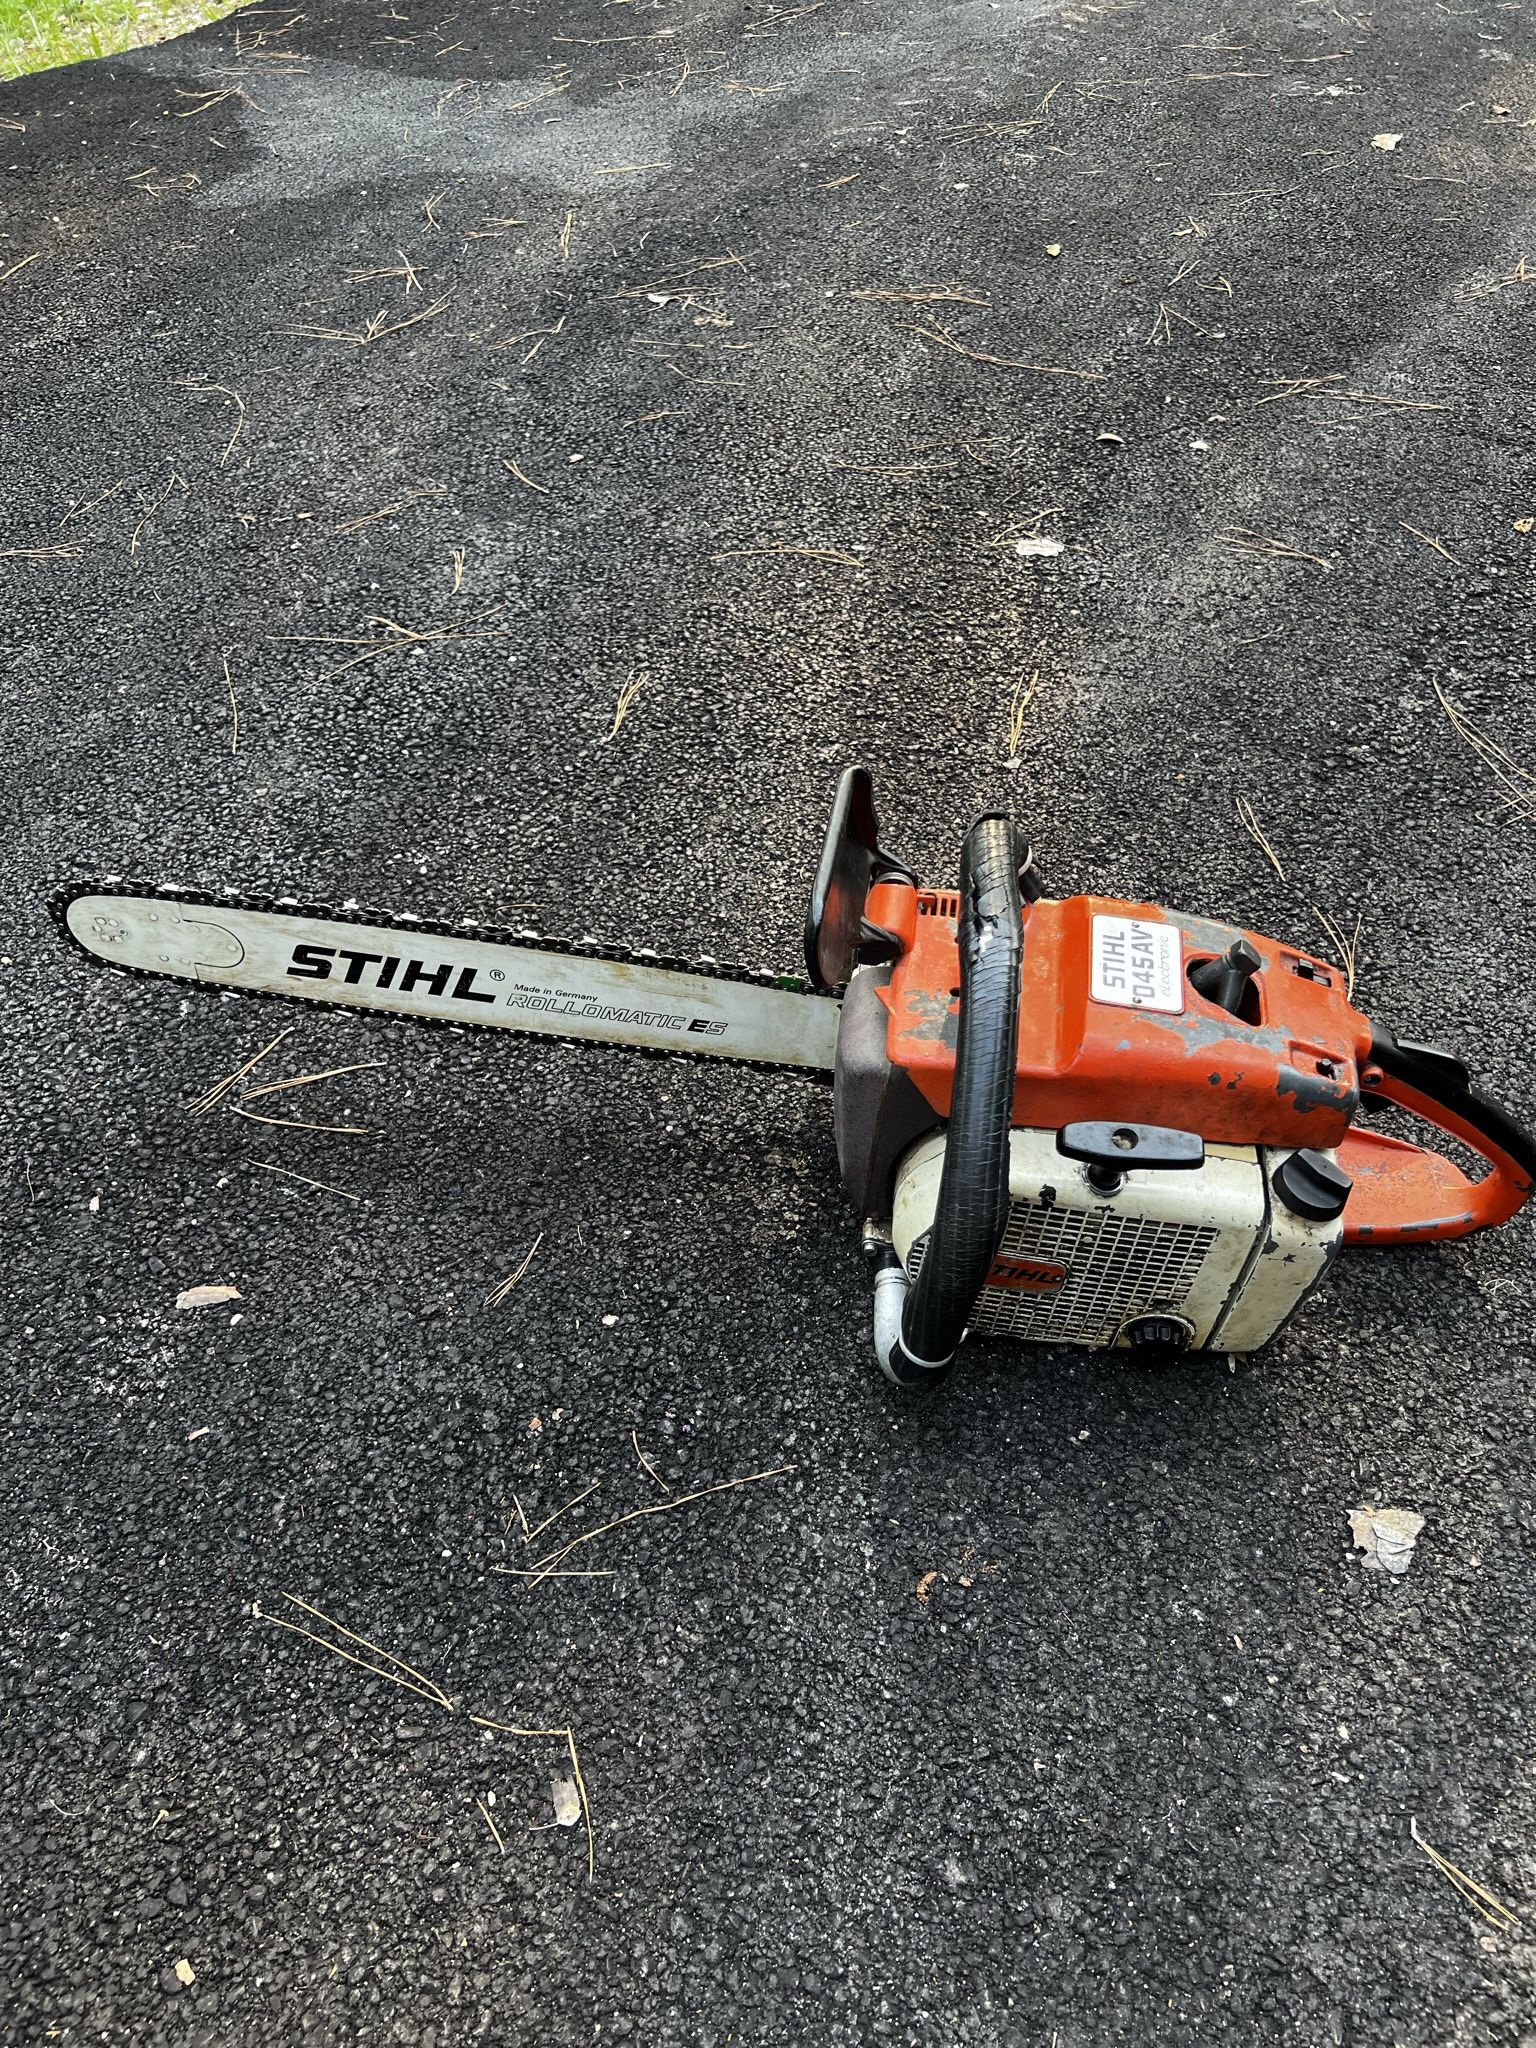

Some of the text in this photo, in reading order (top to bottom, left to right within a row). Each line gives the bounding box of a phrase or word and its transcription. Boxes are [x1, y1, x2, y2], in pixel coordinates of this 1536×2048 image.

[1102, 931, 1125, 989] STIHL
[1159, 935, 1172, 997] electronic
[506, 993, 729, 1036] ROLLOMATIC ES
[513, 983, 541, 994] Made
[555, 989, 599, 1003] Germany
[991, 1263, 1055, 1285] TIHL
